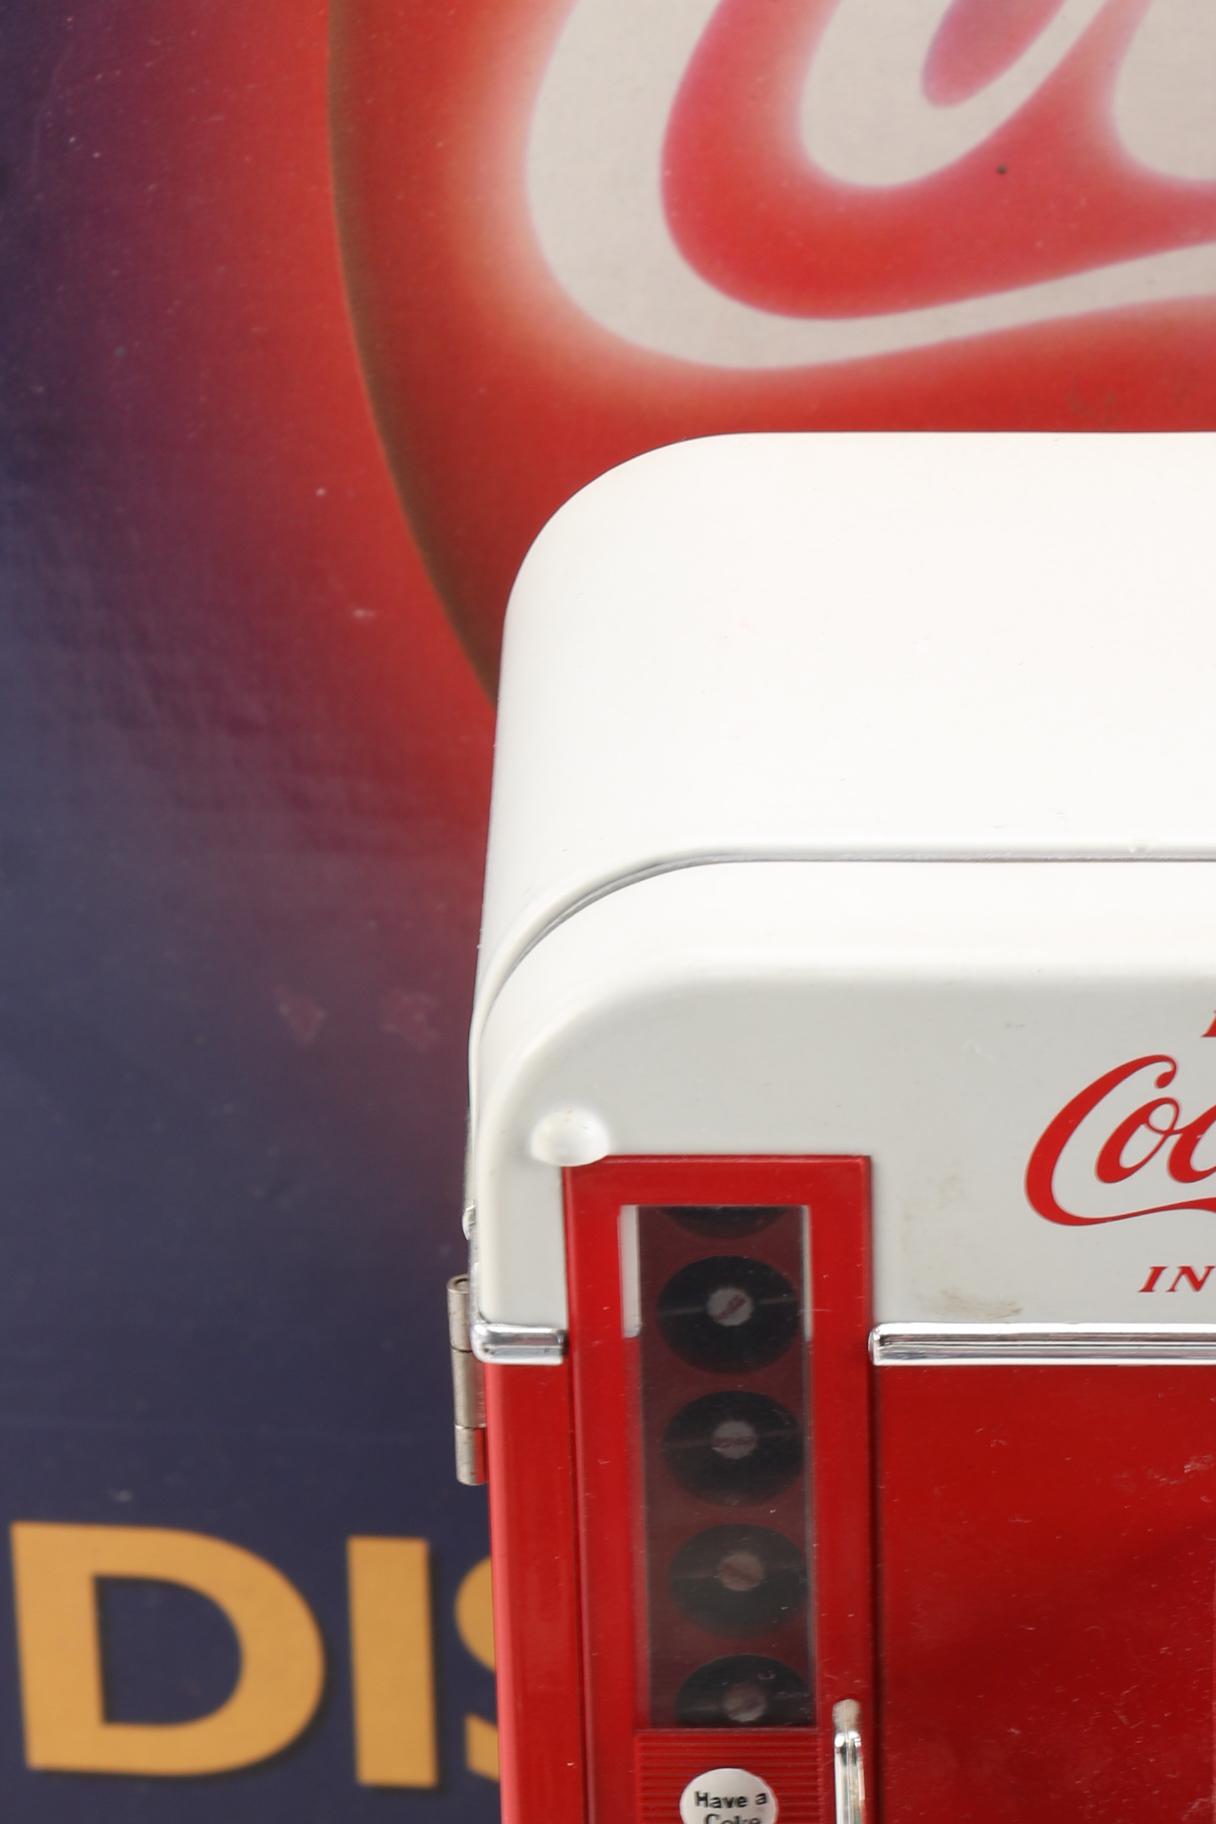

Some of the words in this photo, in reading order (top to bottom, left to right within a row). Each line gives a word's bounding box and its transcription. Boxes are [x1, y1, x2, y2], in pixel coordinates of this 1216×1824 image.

[1138, 1265, 1216, 1293] IN
[10, 1520, 500, 1790] DI
[694, 1791, 748, 1809] Have
[755, 1792, 768, 1805] a
